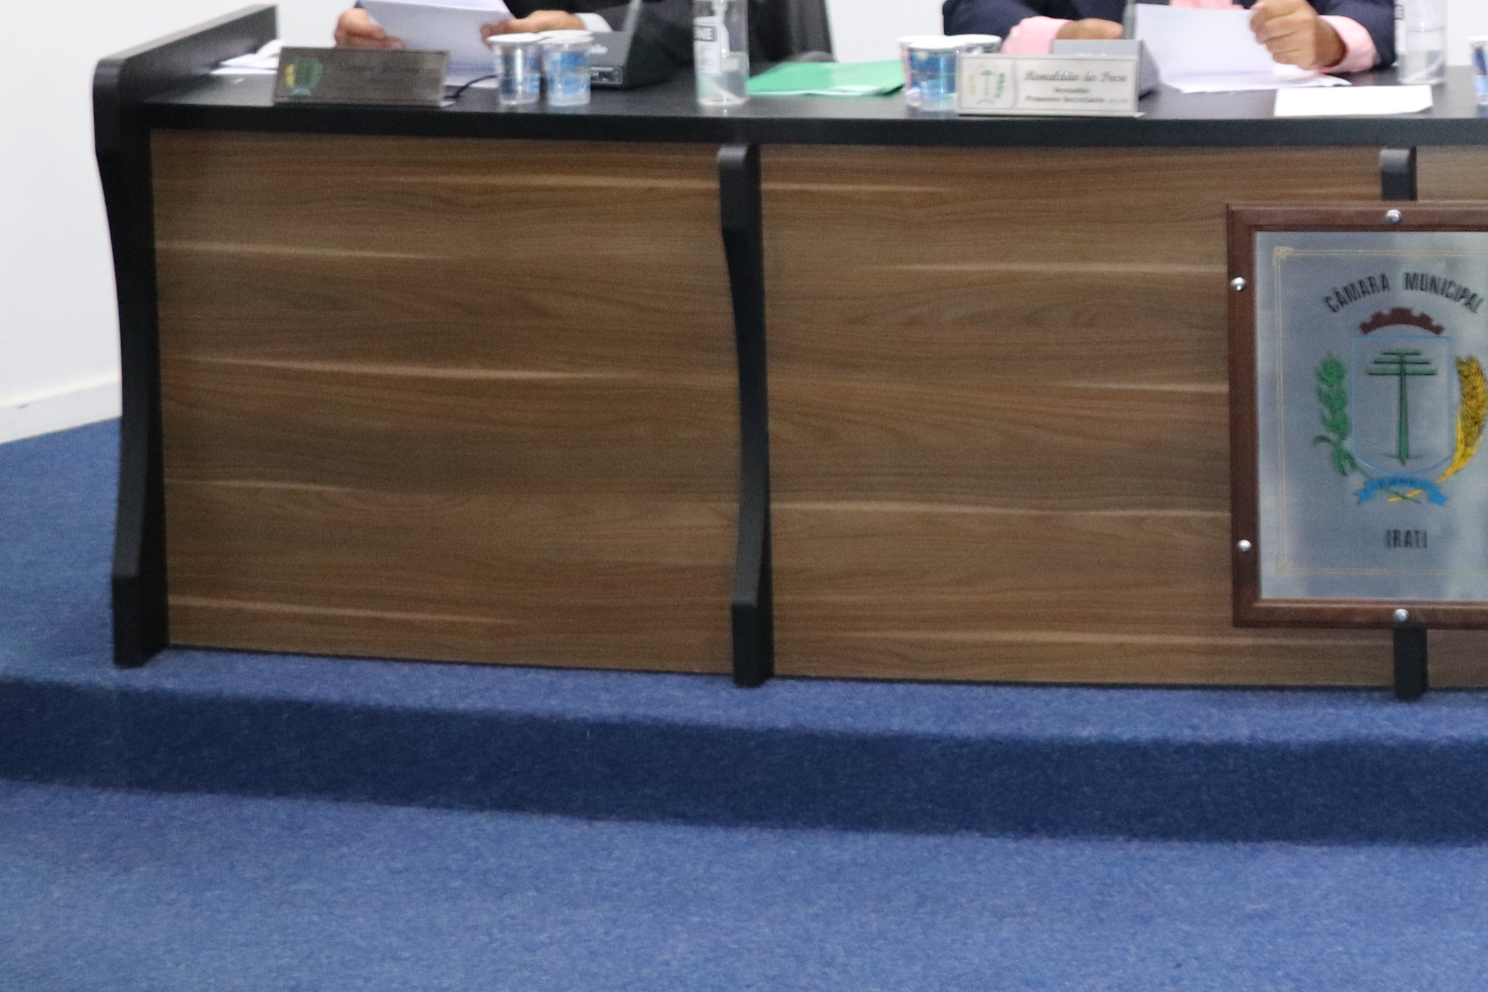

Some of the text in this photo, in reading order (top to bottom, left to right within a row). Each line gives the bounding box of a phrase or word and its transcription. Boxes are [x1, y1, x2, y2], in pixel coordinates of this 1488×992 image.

[1324, 272, 1484, 314] CÂMARA MUNICIPAL
[1385, 529, 1428, 549] IRATI
